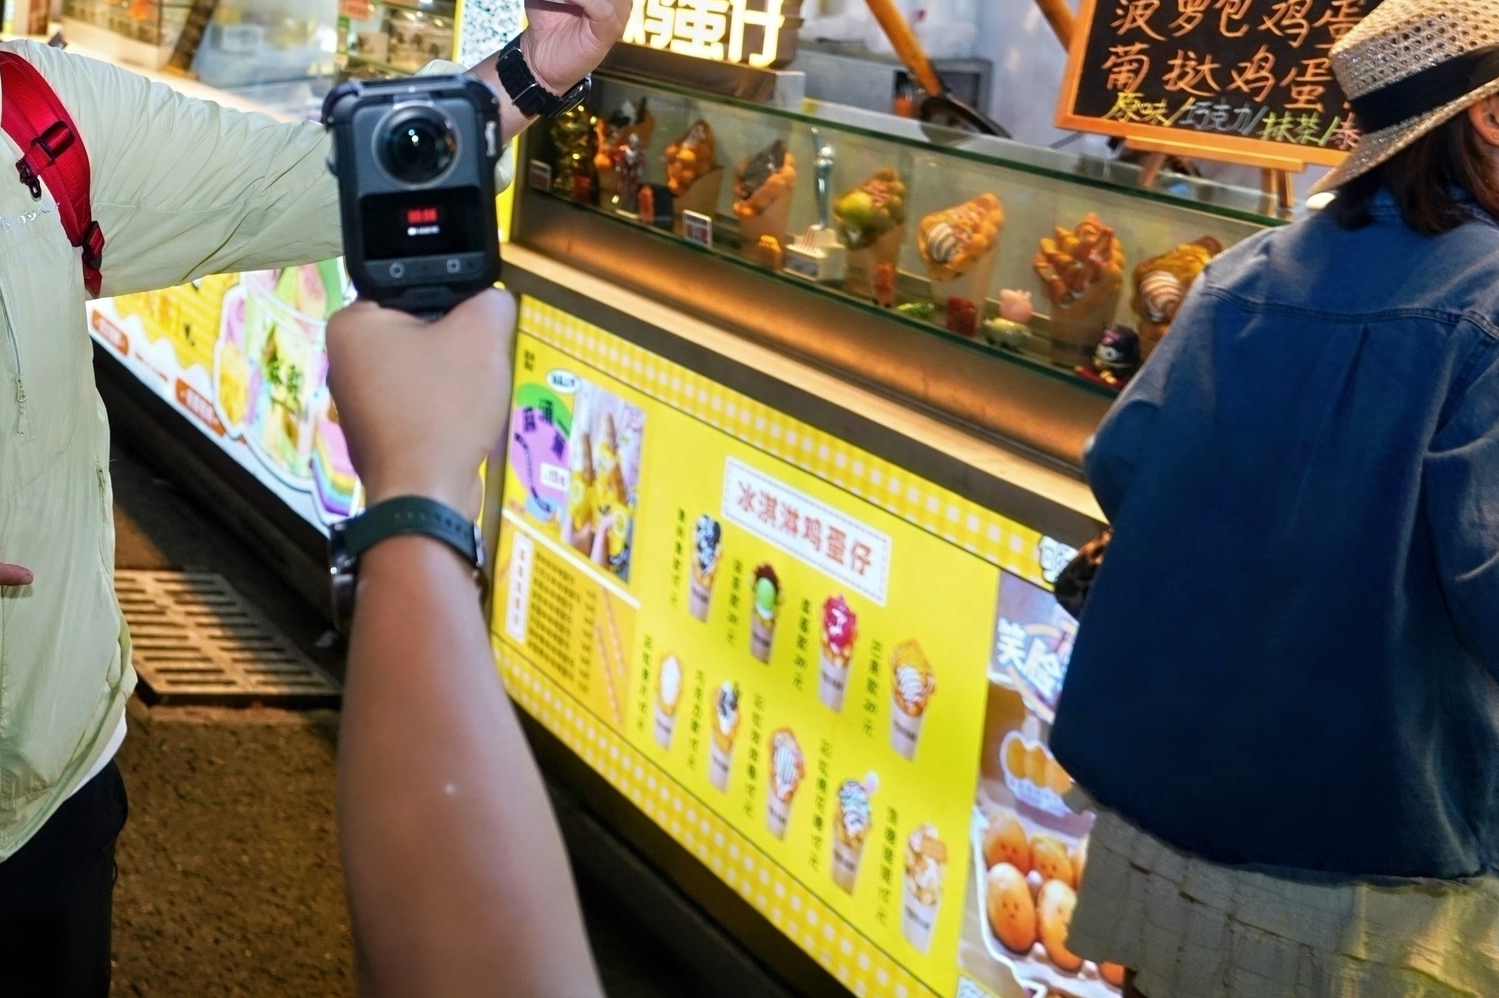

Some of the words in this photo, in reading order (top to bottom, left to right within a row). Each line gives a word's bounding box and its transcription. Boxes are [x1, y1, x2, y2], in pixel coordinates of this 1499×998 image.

[1101, 42, 1351, 113] 葡挞鸡蛋
[736, 478, 873, 577] 冰淇淋鸡蛋仔
